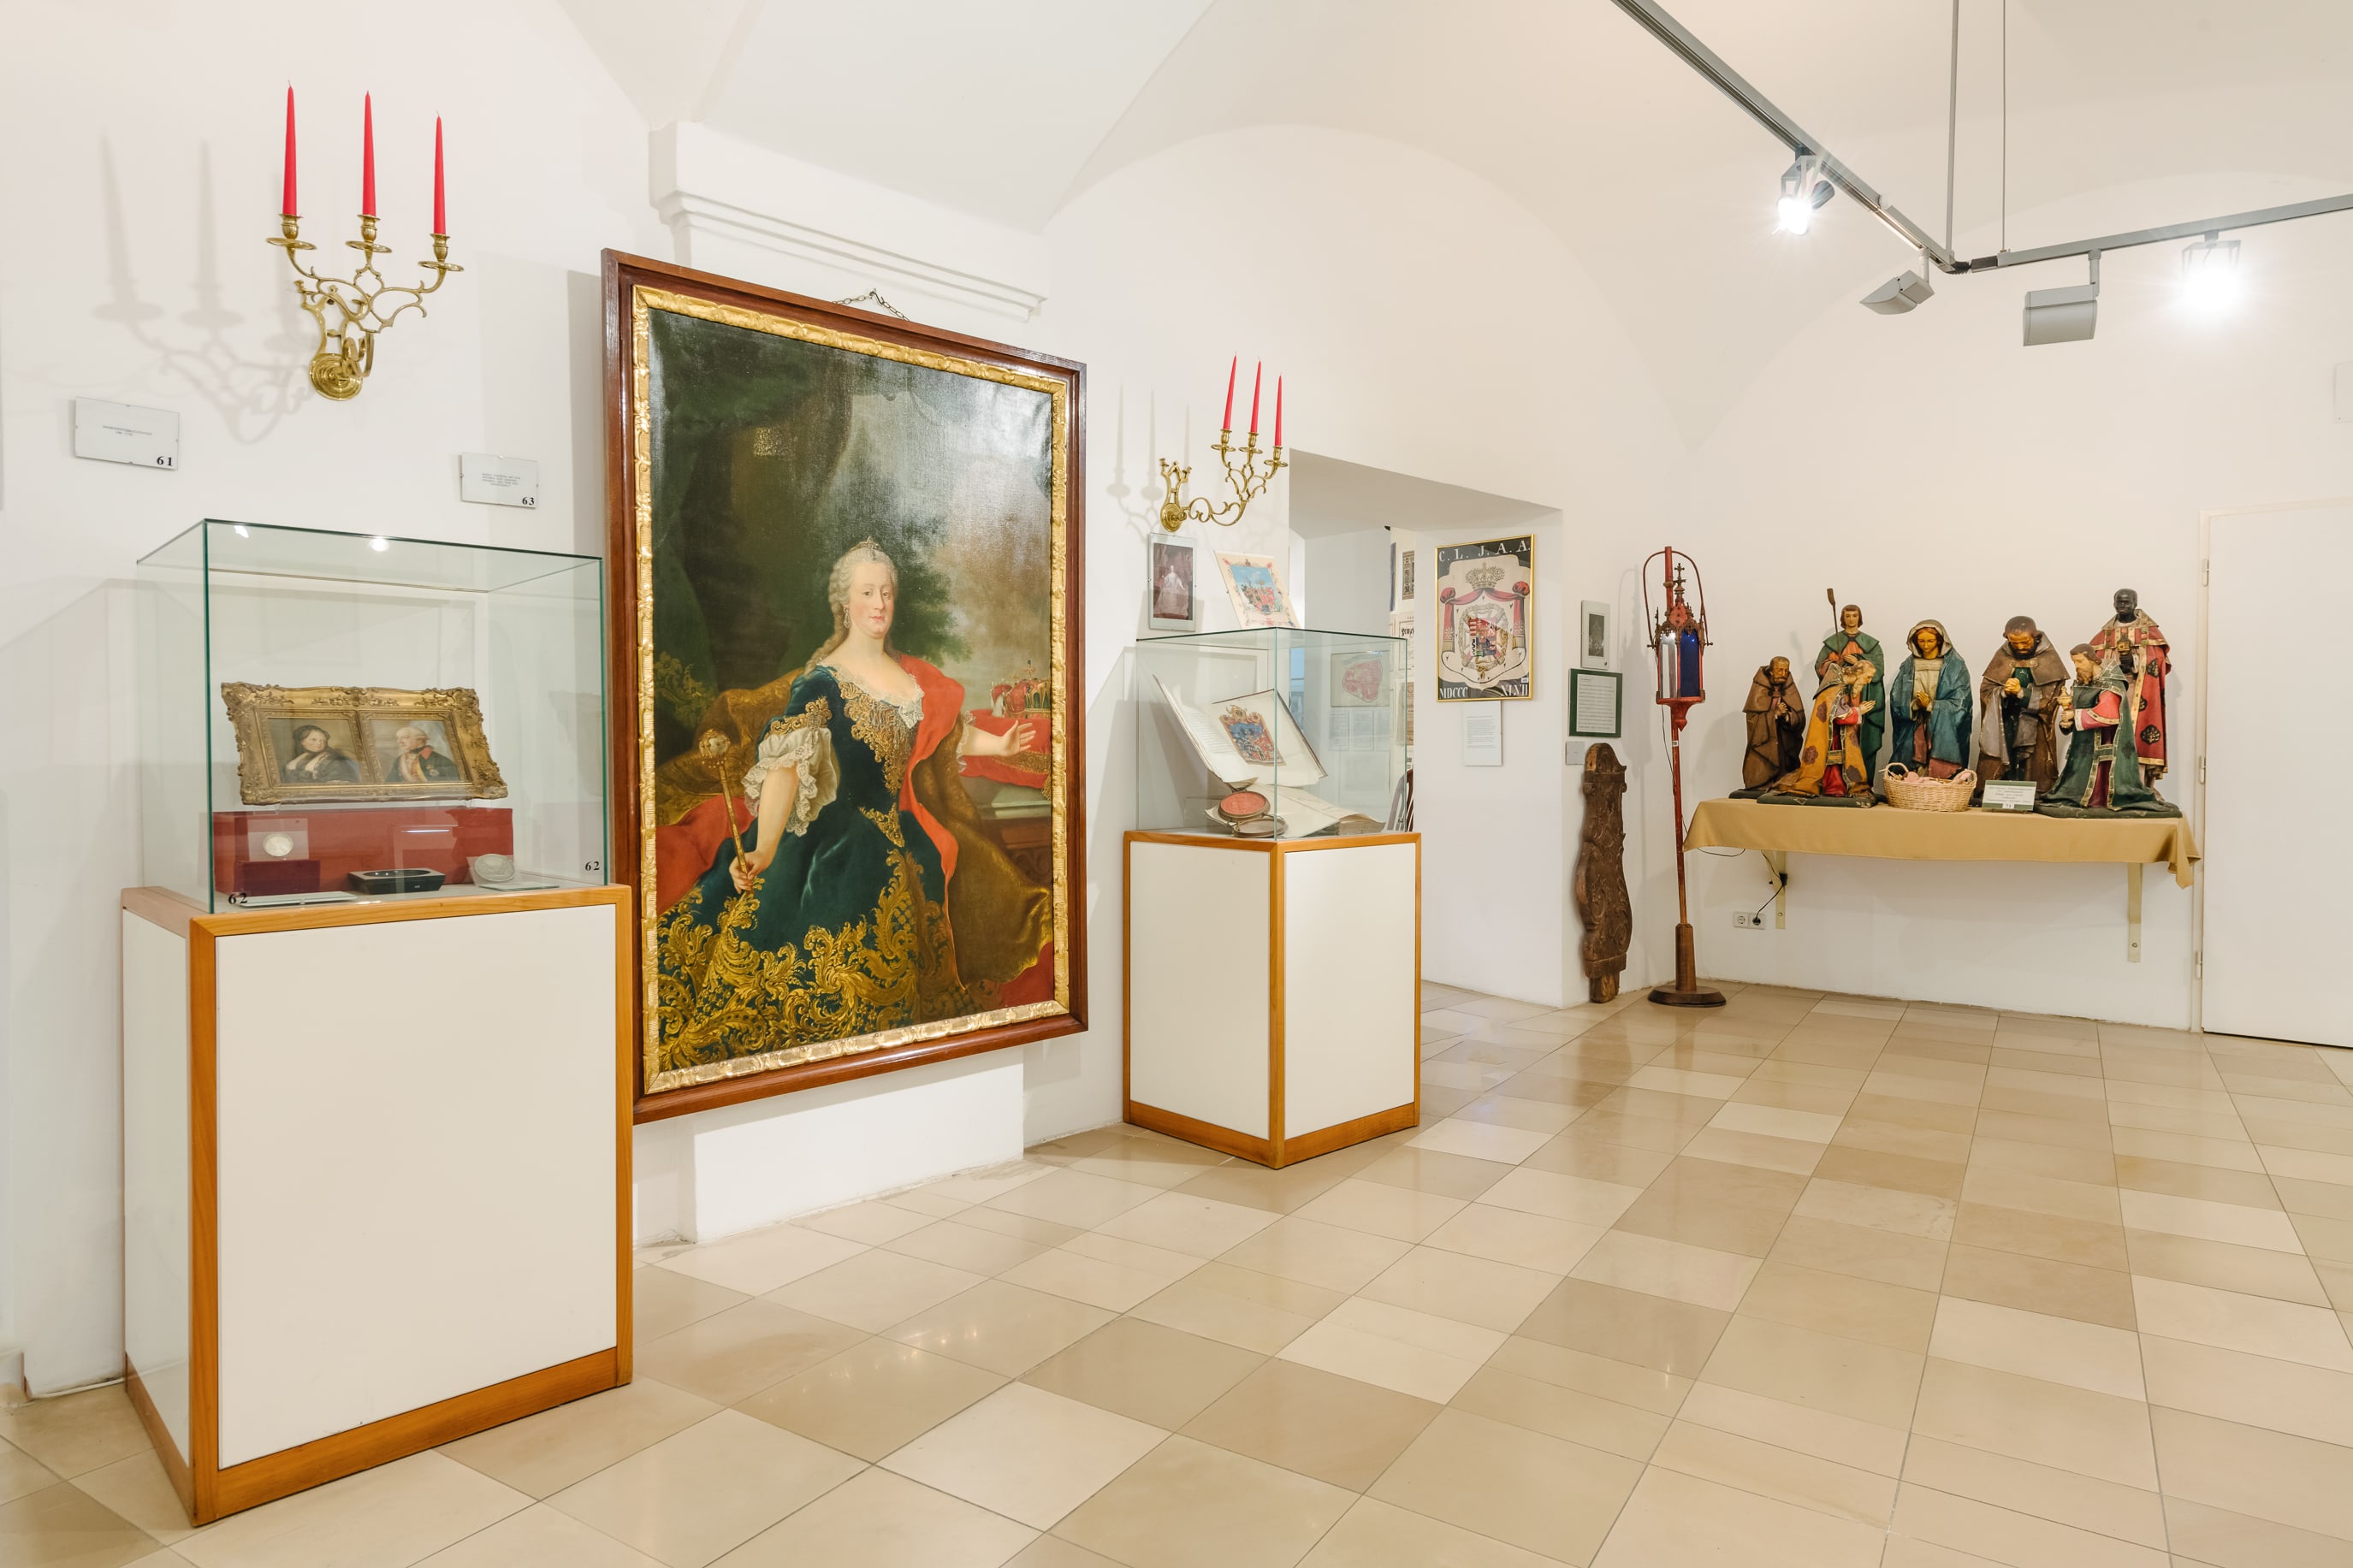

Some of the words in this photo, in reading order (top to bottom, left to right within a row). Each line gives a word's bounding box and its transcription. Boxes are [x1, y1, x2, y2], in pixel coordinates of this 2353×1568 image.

[157, 455, 173, 466] 61
[522, 496, 535, 506] 63
[1438, 550, 1450, 562] C.
[1454, 548, 1469, 560] L.
[1495, 542, 1513, 555] A.
[1516, 540, 1531, 553] A.
[1439, 686, 1468, 700] MDCCC
[584, 861, 600, 871] 62
[228, 892, 248, 905] 62
